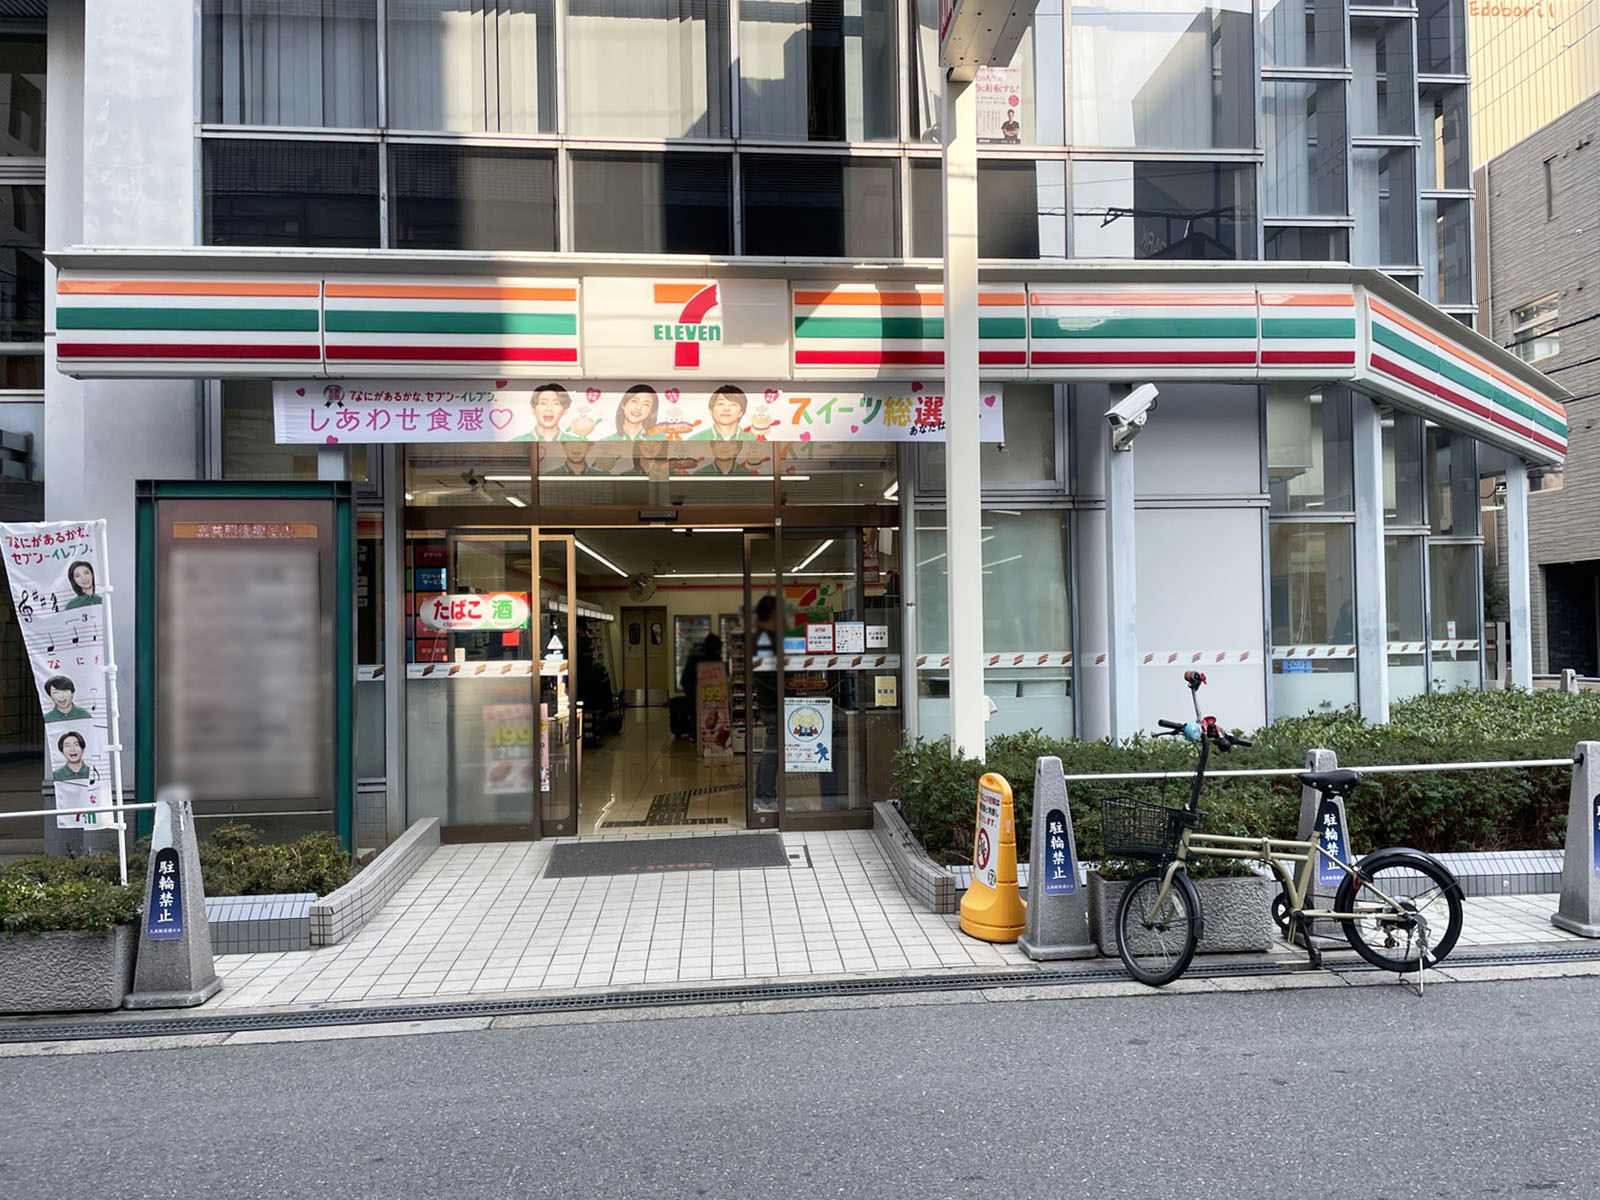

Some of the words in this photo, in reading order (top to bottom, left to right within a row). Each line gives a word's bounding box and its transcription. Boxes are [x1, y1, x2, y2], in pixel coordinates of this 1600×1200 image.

[654, 284, 718, 368] 7
[434, 601, 482, 620] たばこ
[492, 599, 513, 620] 酒
[1049, 821, 1067, 880] 駐輪禁止
[1323, 813, 1342, 872] 駐輪禁止
[157, 860, 176, 923] 駐輪禁止
